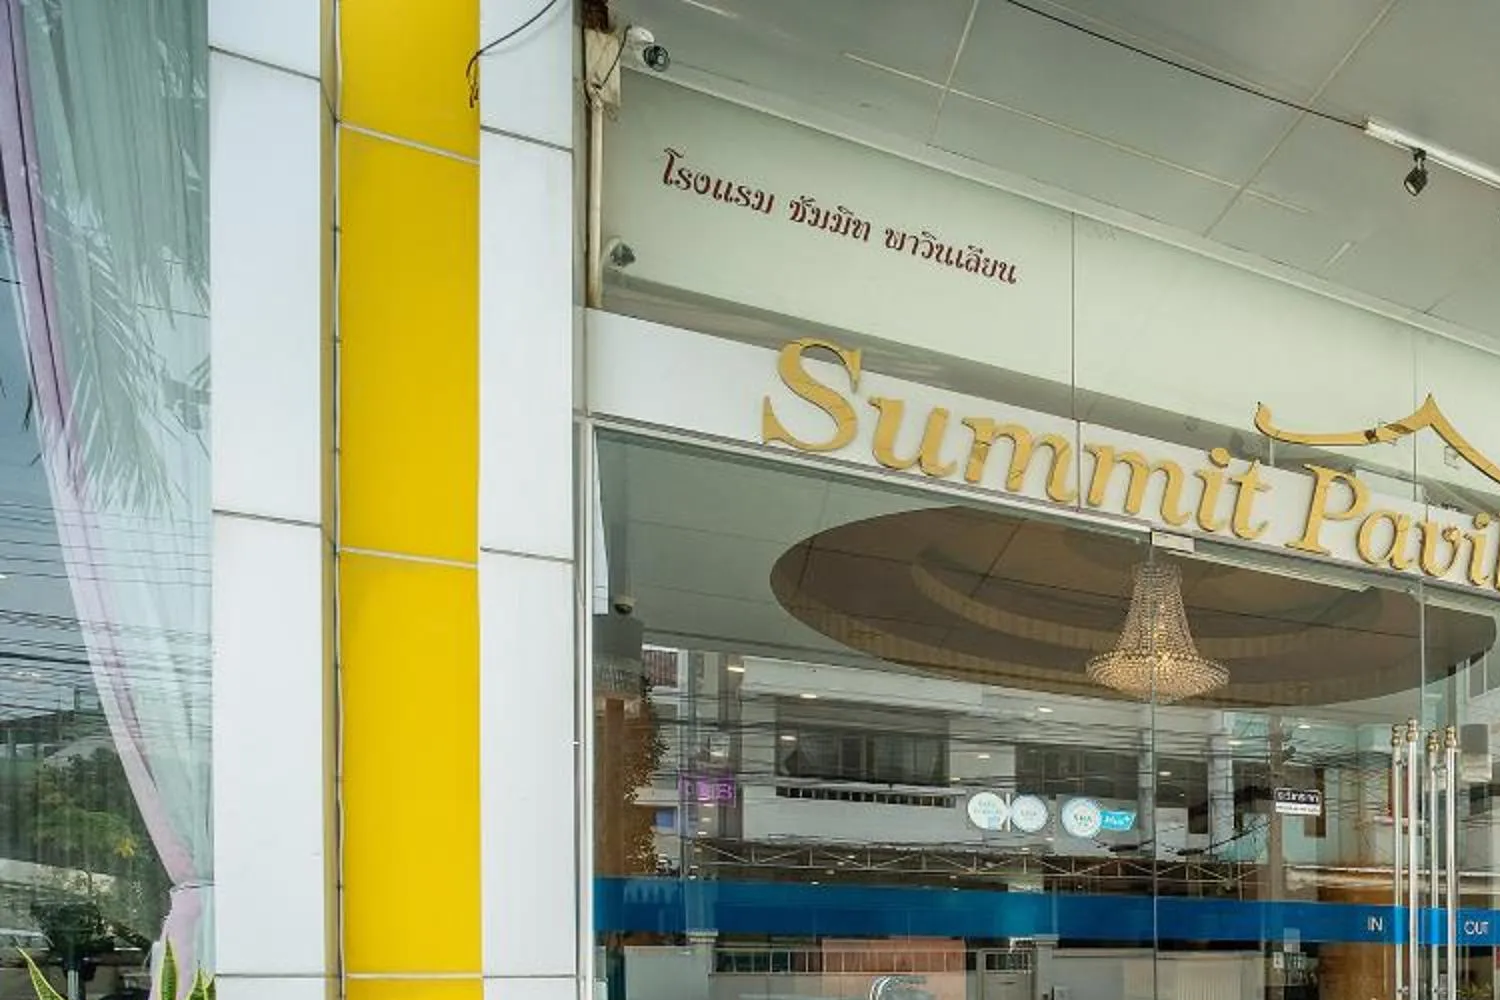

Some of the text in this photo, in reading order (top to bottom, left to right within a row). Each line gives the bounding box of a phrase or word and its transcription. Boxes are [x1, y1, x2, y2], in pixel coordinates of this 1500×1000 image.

[662, 147, 775, 214] โรงแรม
[762, 336, 1272, 540] Summit
[1367, 915, 1383, 932] IN
[1463, 920, 1489, 935] OUT
